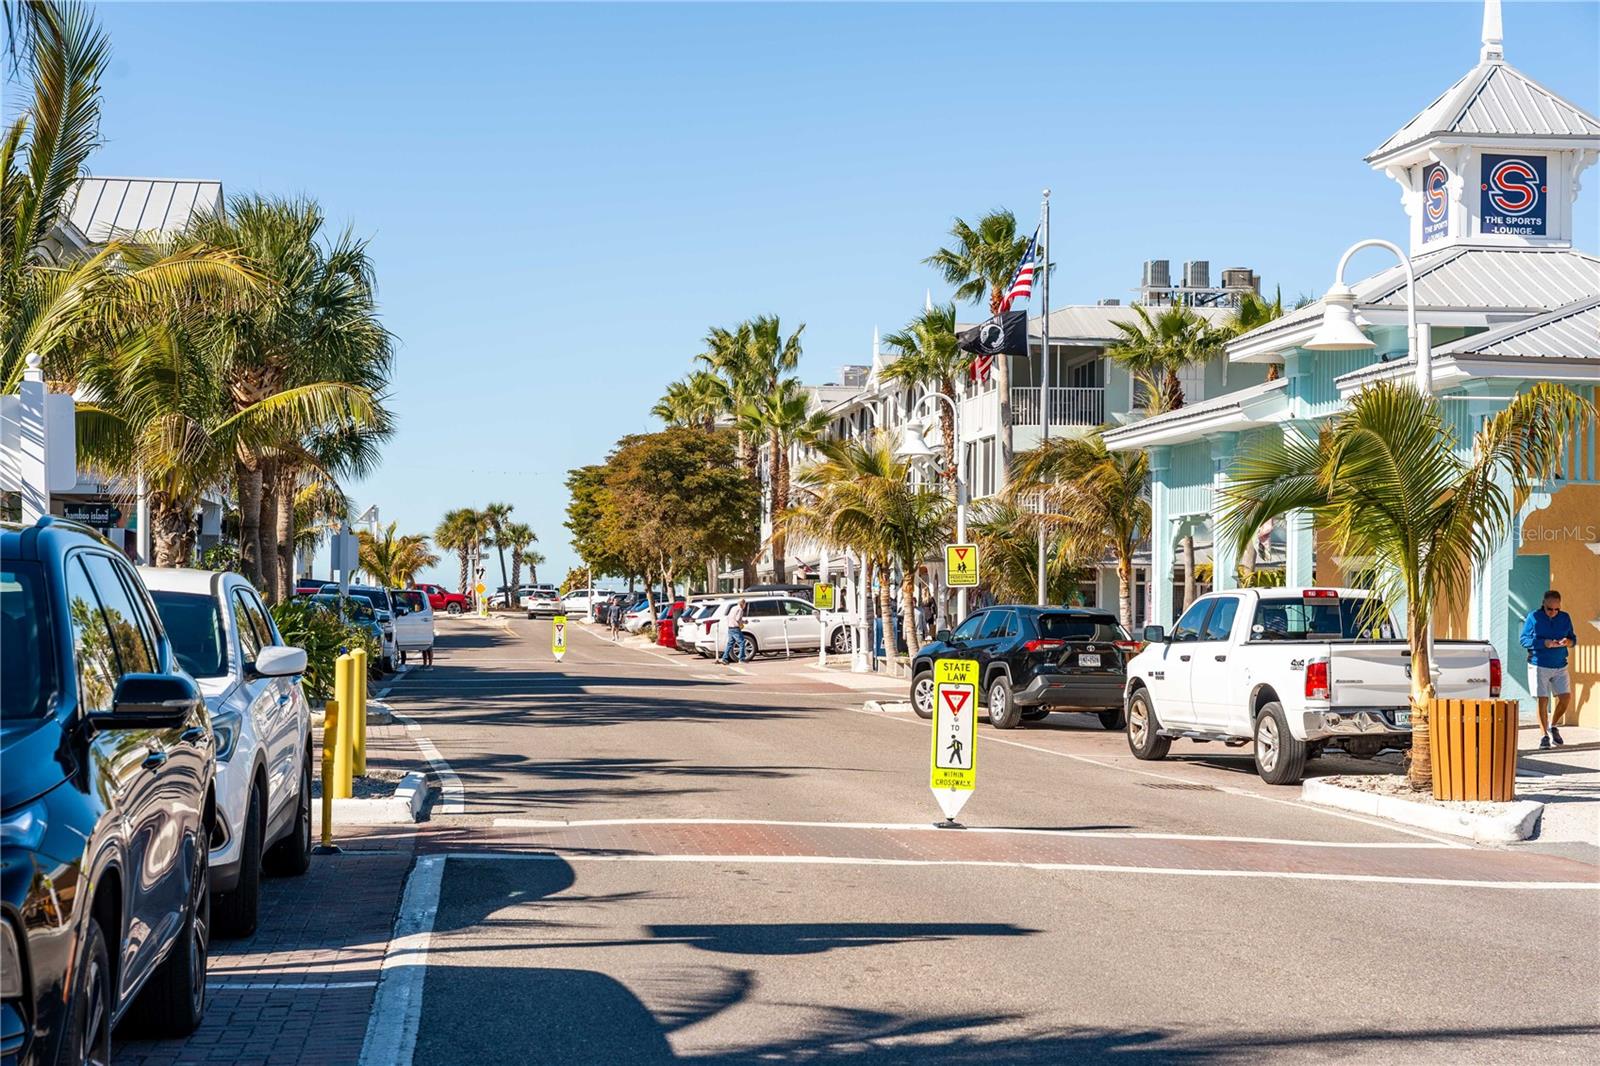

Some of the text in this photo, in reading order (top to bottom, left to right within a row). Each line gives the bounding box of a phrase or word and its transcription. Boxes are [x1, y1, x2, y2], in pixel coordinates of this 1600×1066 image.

[1485, 216, 1542, 226] THE SPORTS
[65, 507, 109, 520] bamboo island
[943, 662, 971, 672] STATE
[947, 673, 966, 682] LAW
[951, 724, 960, 732] TO
[935, 779, 971, 787] CROSSWALK
